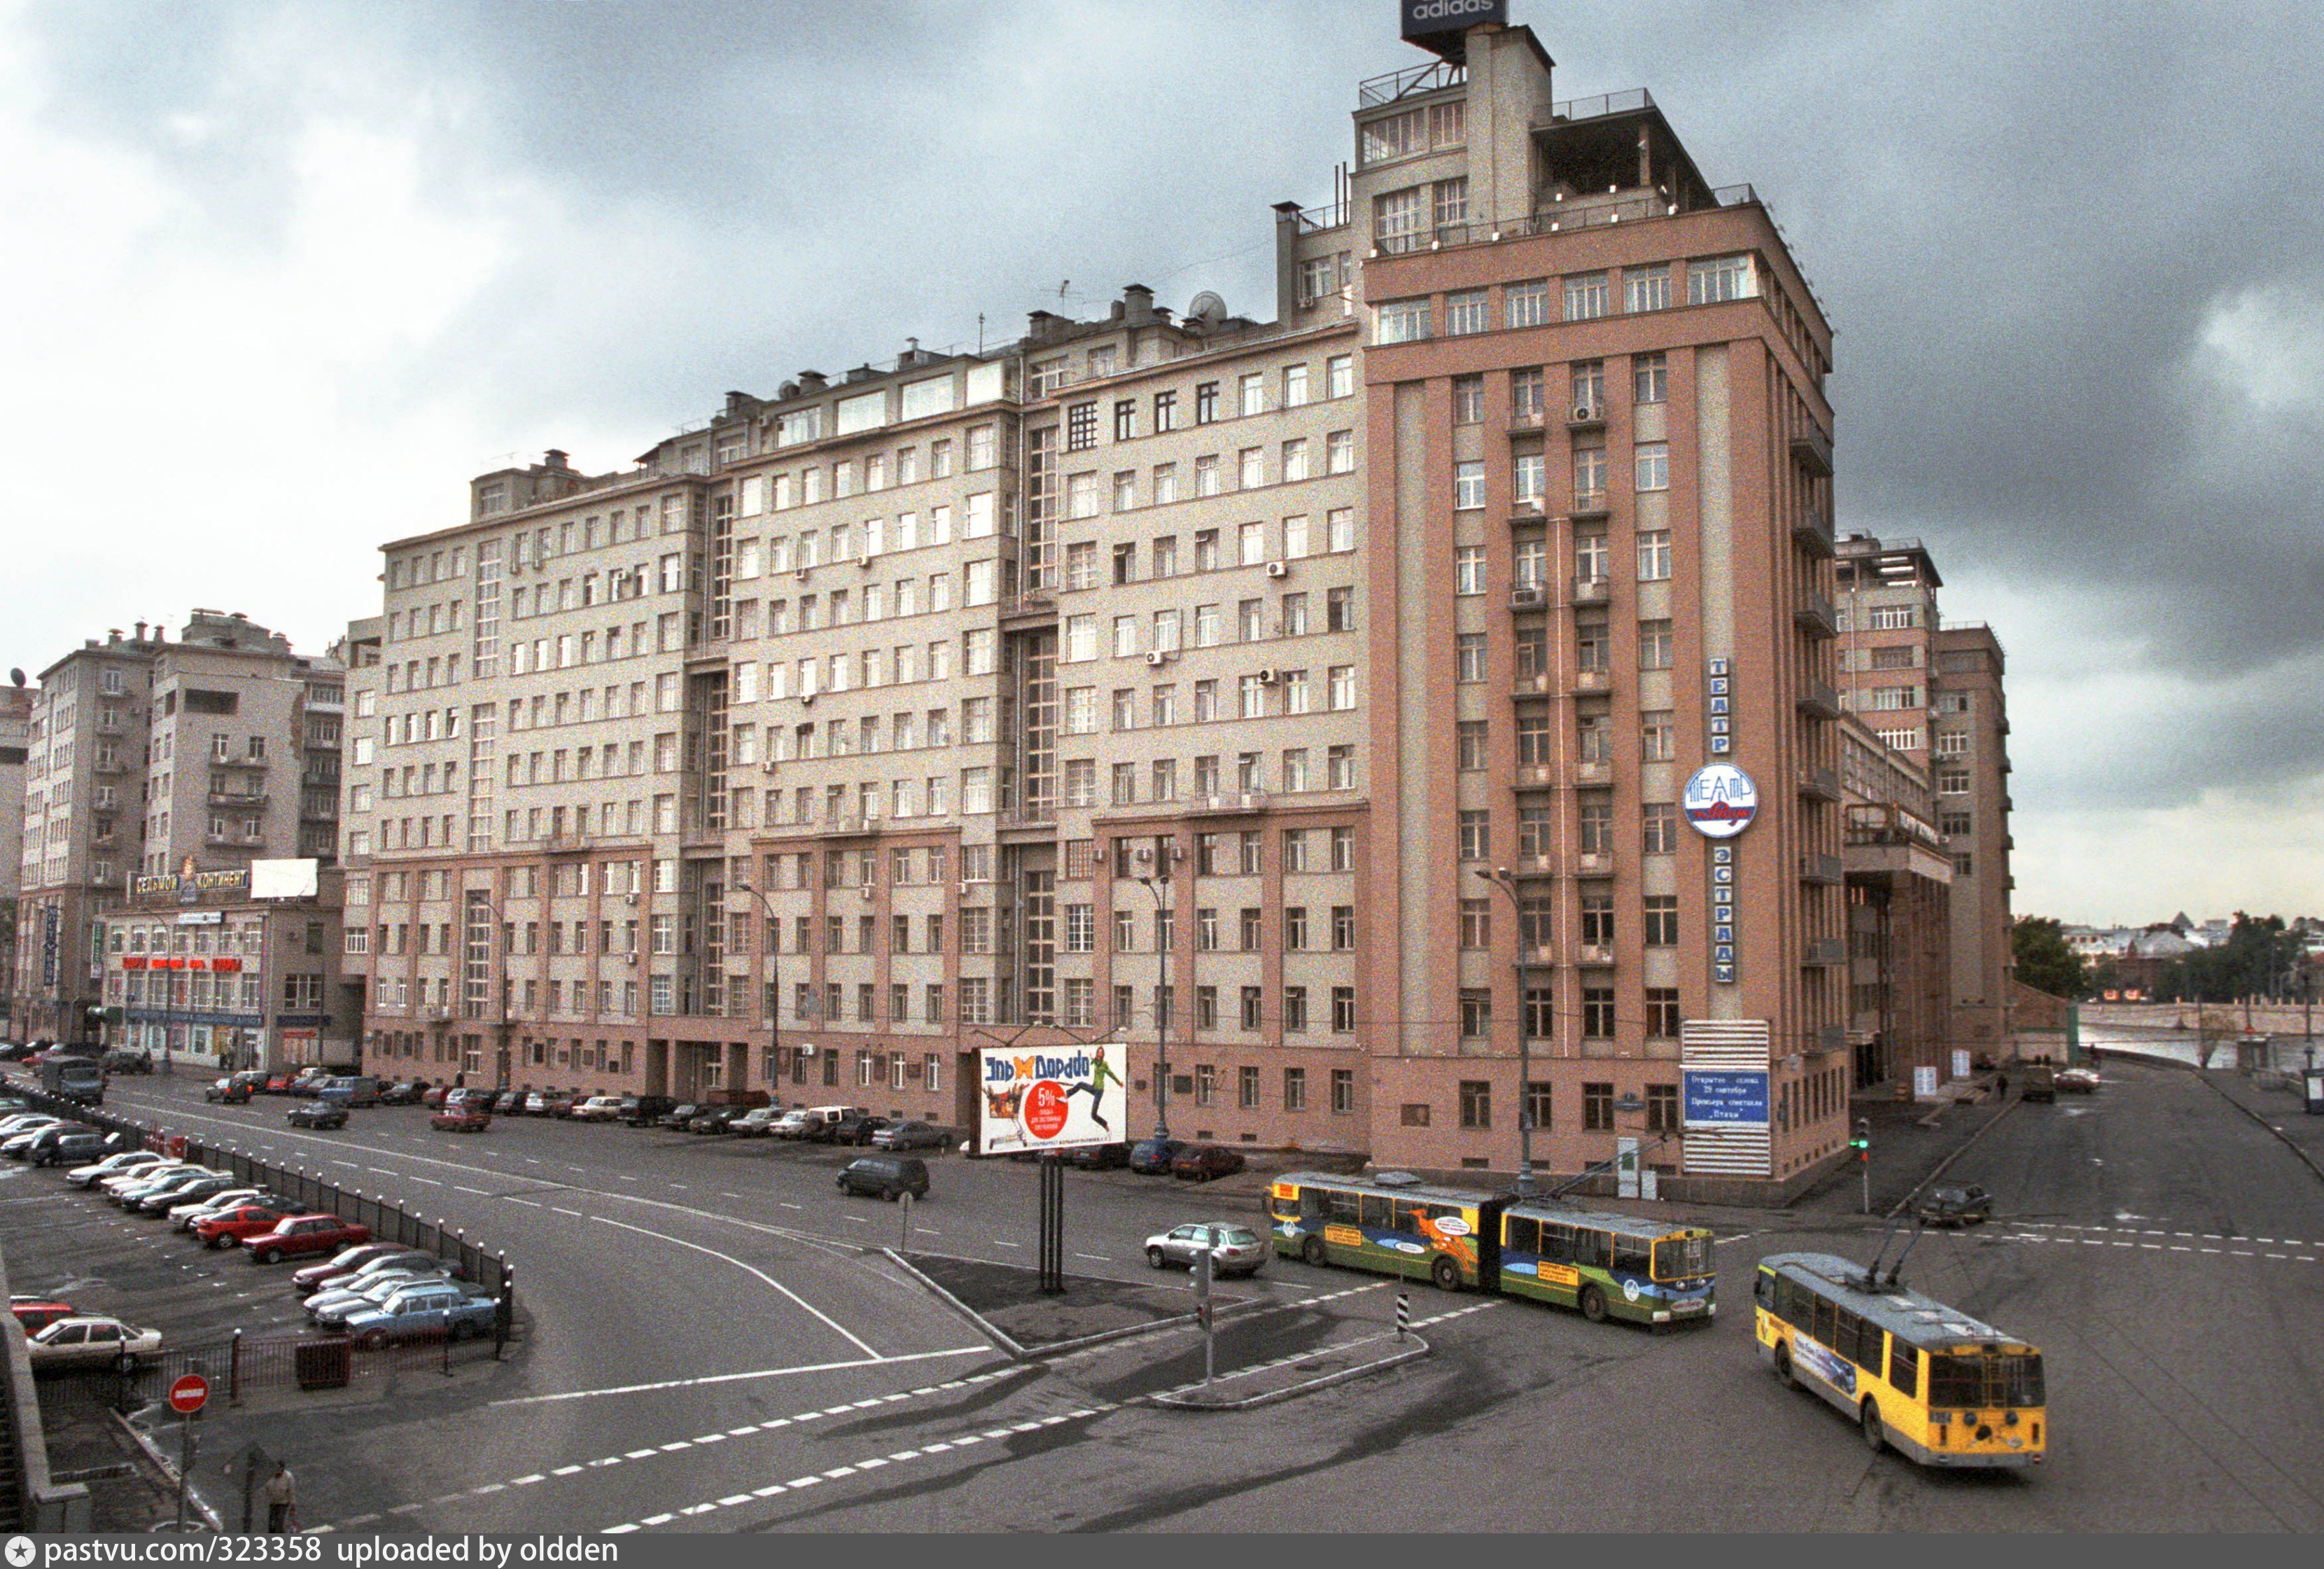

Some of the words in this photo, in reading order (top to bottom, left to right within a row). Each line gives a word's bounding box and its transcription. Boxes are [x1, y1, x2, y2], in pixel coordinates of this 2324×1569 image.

[1413, 0, 1494, 20] adidas
[1712, 659, 1729, 753] ТЕАТР
[1714, 847, 1733, 982] ЭСТРАДЫ
[1038, 1087, 1056, 1107] 5%
